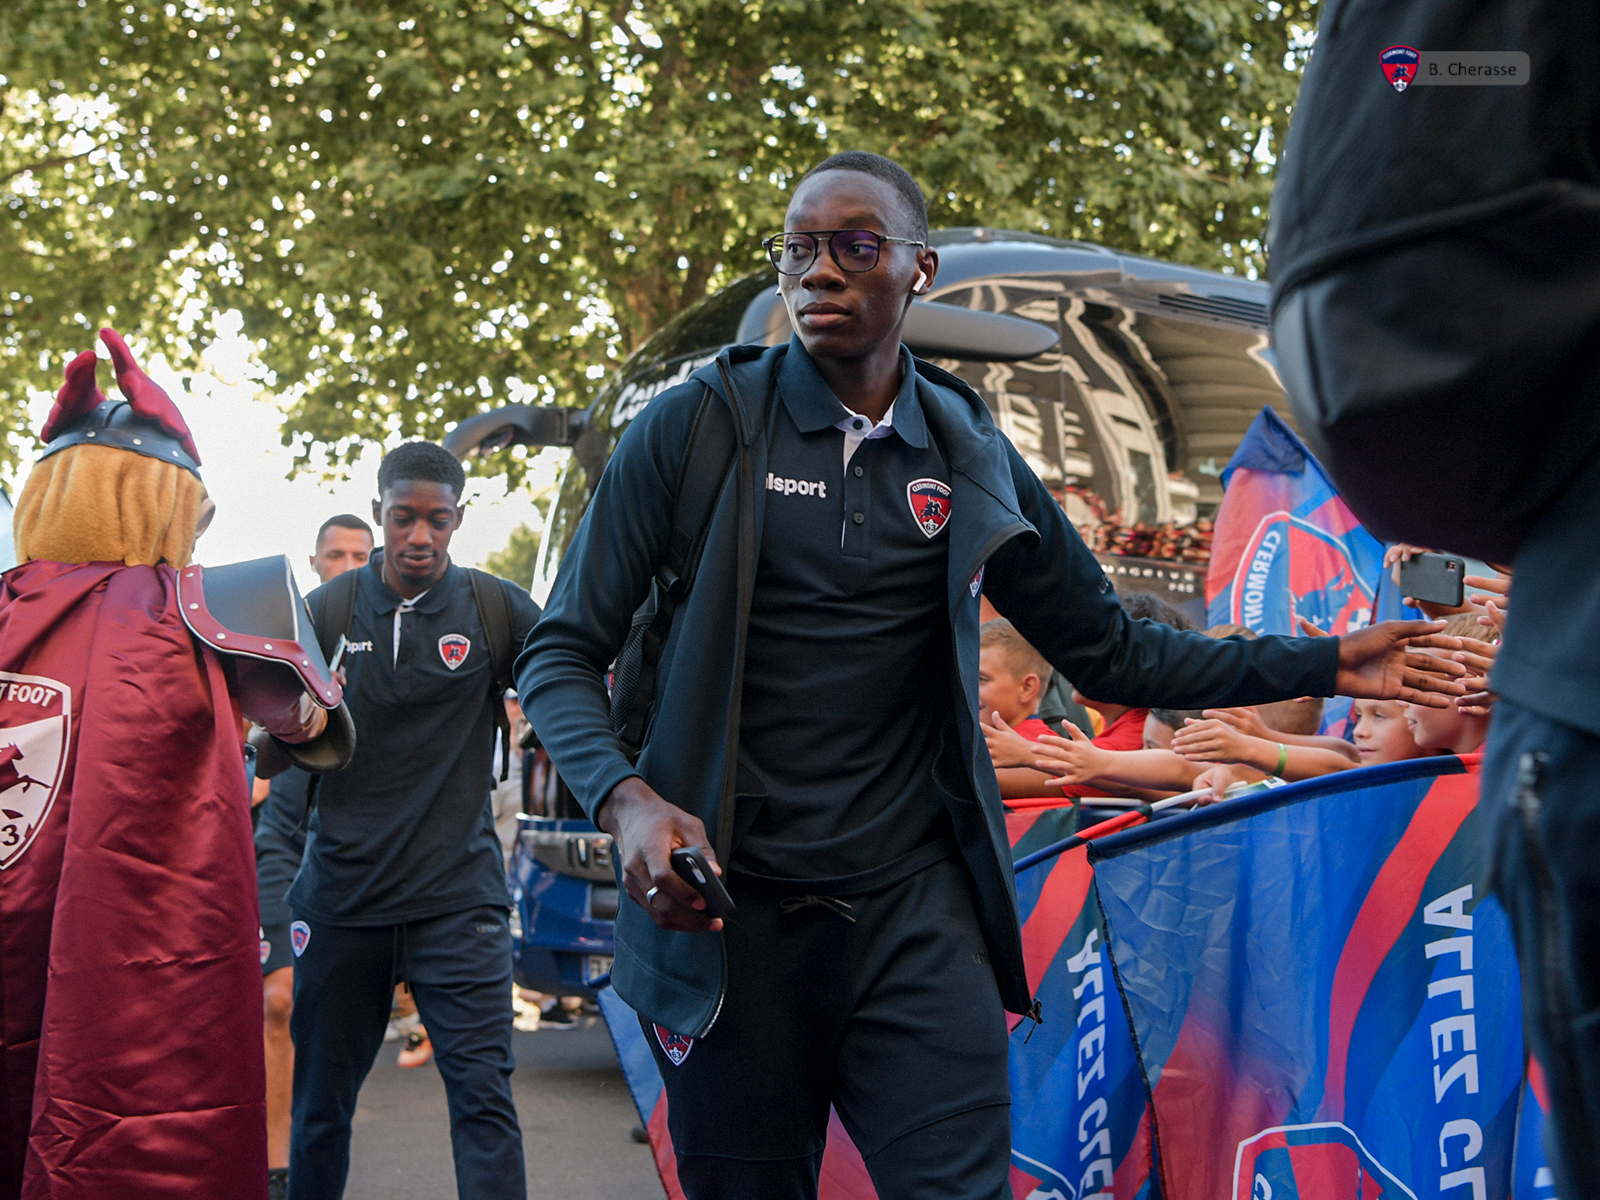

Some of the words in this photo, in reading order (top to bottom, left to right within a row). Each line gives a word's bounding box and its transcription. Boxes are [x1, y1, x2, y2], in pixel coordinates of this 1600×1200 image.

[765, 472, 826, 498] lsport
[912, 483, 937, 493] CLERMONT
[937, 485, 950, 497] FOOT
[7, 684, 57, 707] FOOT
